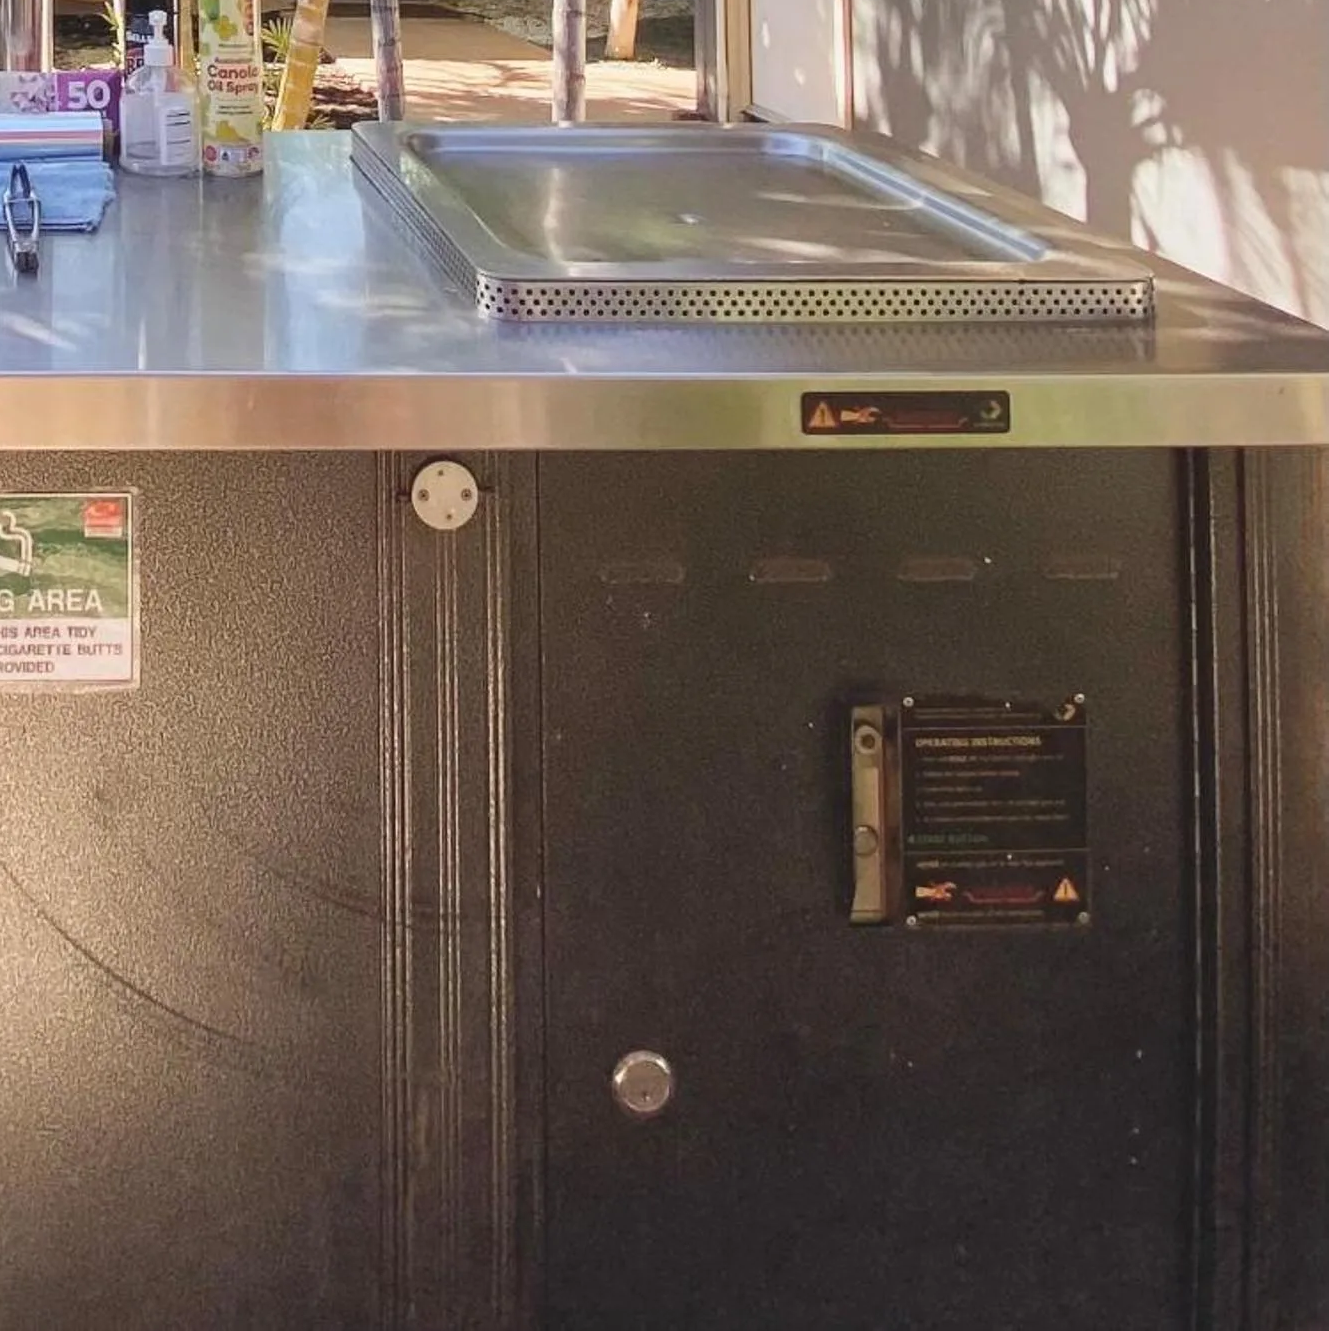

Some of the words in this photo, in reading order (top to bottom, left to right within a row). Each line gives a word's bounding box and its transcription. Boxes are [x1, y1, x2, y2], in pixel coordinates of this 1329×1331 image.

[207, 80, 223, 91] Oil
[68, 79, 111, 110] 50
[27, 588, 104, 613] AREA
[24, 626, 61, 640] AREA
[67, 626, 97, 640] TIDY
[77, 644, 124, 656] BUTTS
[915, 737, 969, 748] OPERATING
[971, 735, 1043, 747] INSTRUCTIONS
